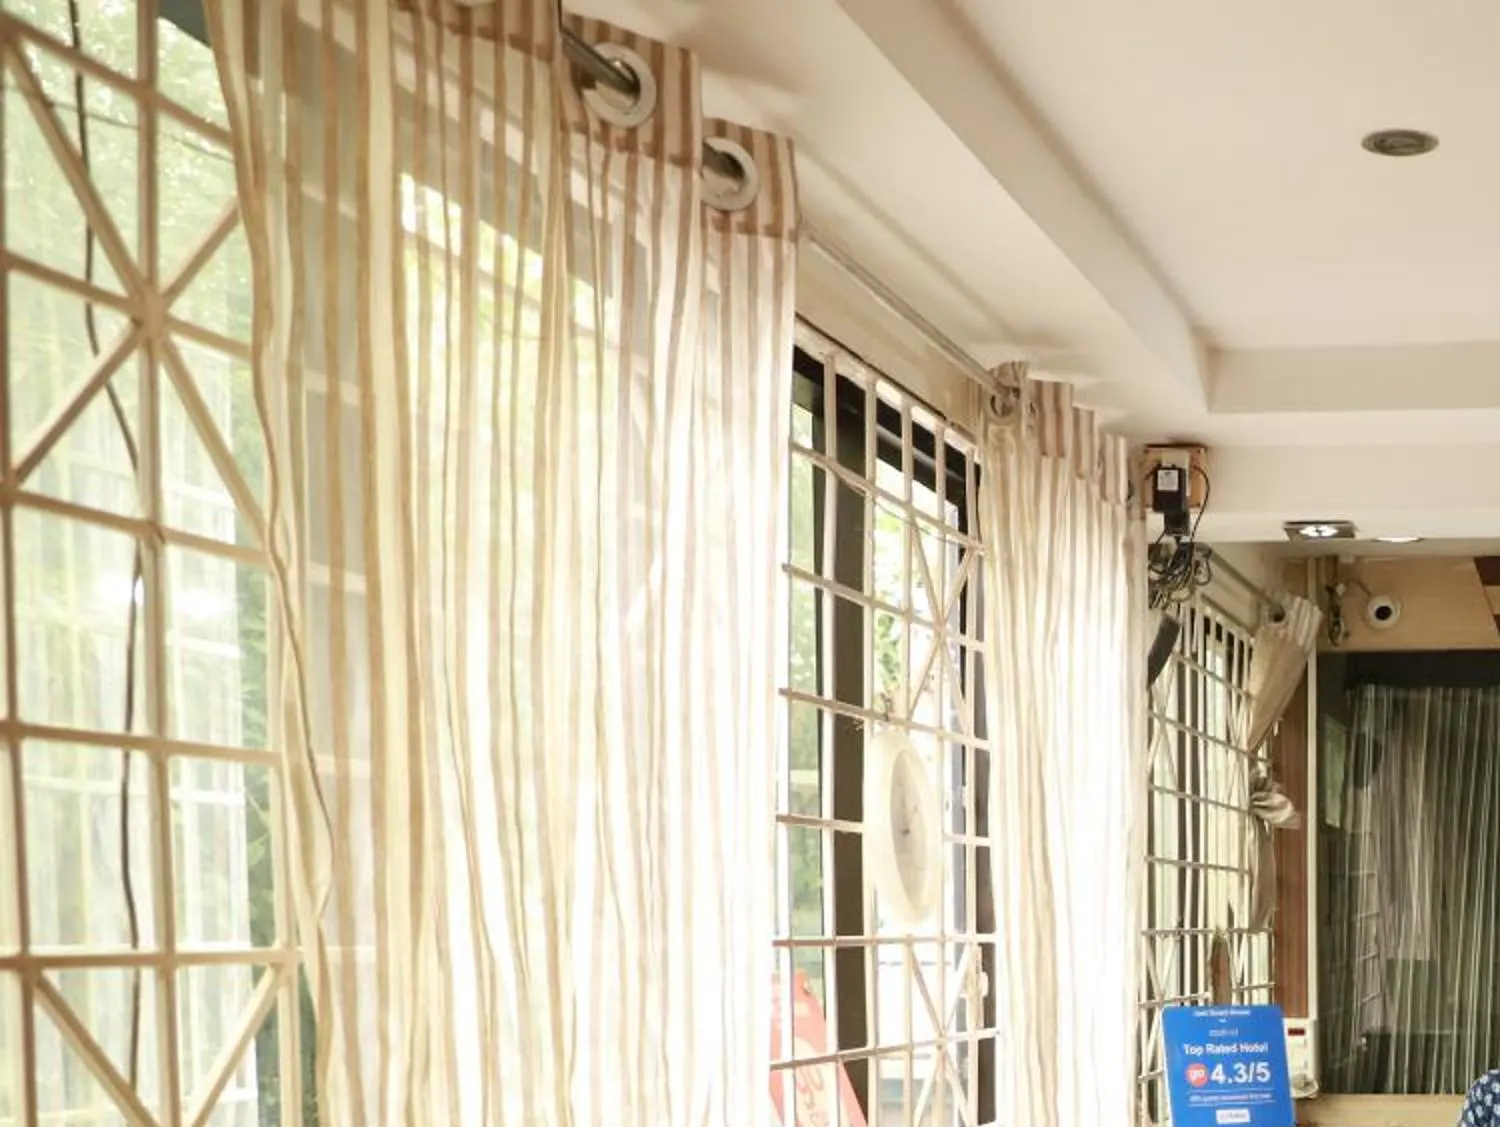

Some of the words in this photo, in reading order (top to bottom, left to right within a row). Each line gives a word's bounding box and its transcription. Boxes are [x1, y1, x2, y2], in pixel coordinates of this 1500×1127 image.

[1183, 1043, 1205, 1057] Top
[1205, 1043, 1239, 1055] Rated
[1239, 1042, 1269, 1053] Hotel
[1210, 1061, 1272, 1085] 4.3/5
